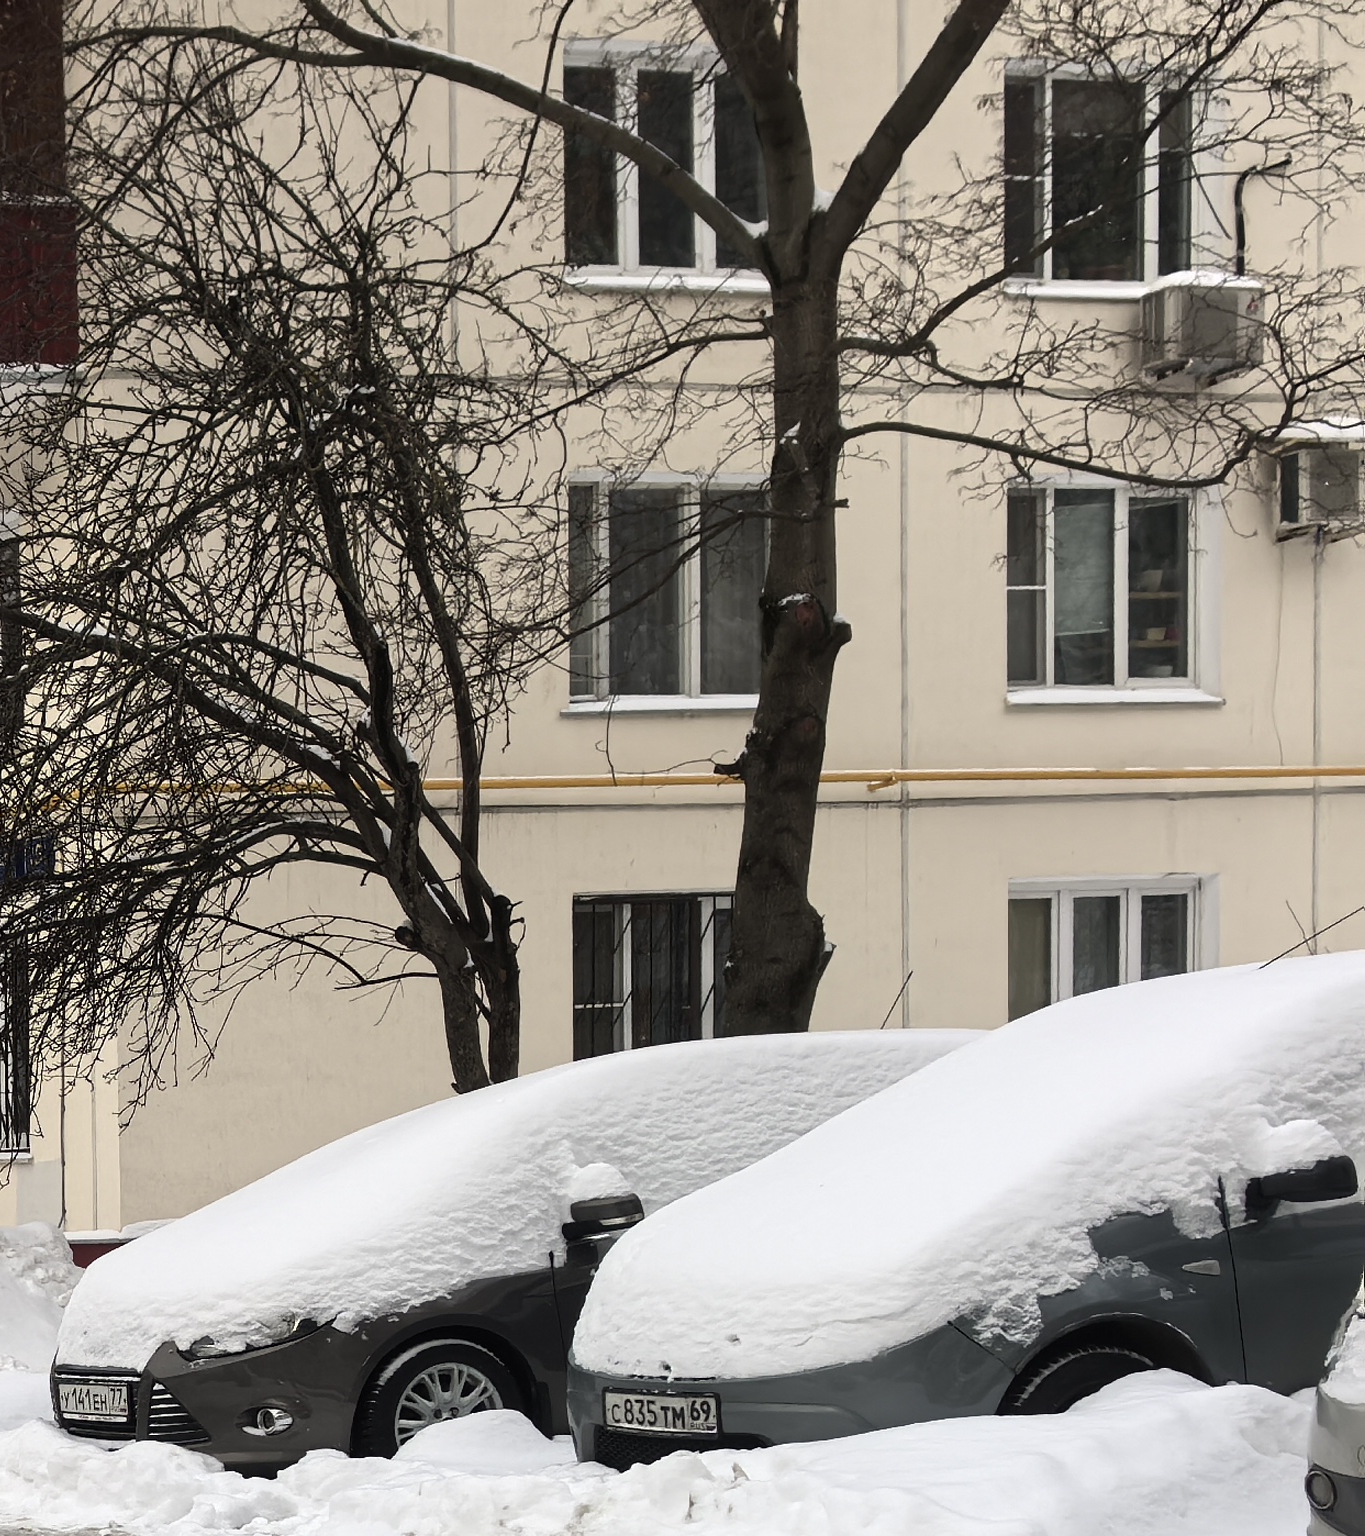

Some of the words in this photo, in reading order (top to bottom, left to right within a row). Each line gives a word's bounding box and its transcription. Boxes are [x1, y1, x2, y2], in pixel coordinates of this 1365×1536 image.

[63, 1387, 108, 1411] У141ЕН
[110, 1387, 122, 1406] 77
[611, 1398, 686, 1430] С835ТМ
[690, 1400, 711, 1422] 69
